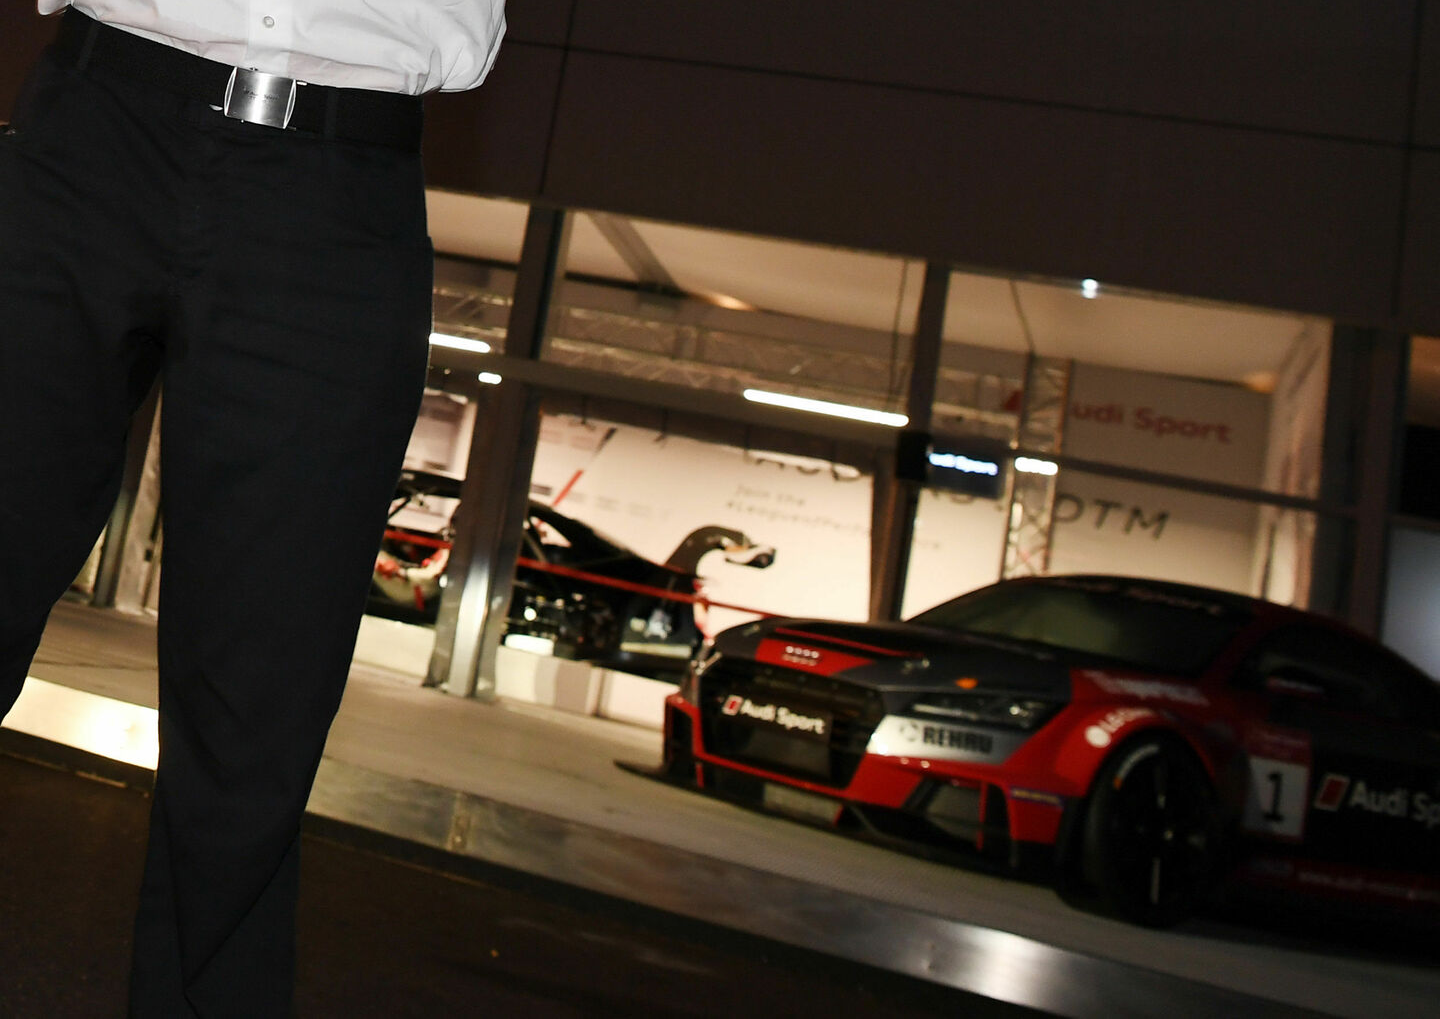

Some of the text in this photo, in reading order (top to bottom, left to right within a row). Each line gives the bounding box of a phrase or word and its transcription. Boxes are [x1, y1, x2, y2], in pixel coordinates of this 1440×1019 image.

[740, 699, 825, 735] Audi Sport
[922, 726, 994, 755] REHAU
[1263, 770, 1286, 822] 1
[1348, 779, 1410, 818] Audi
